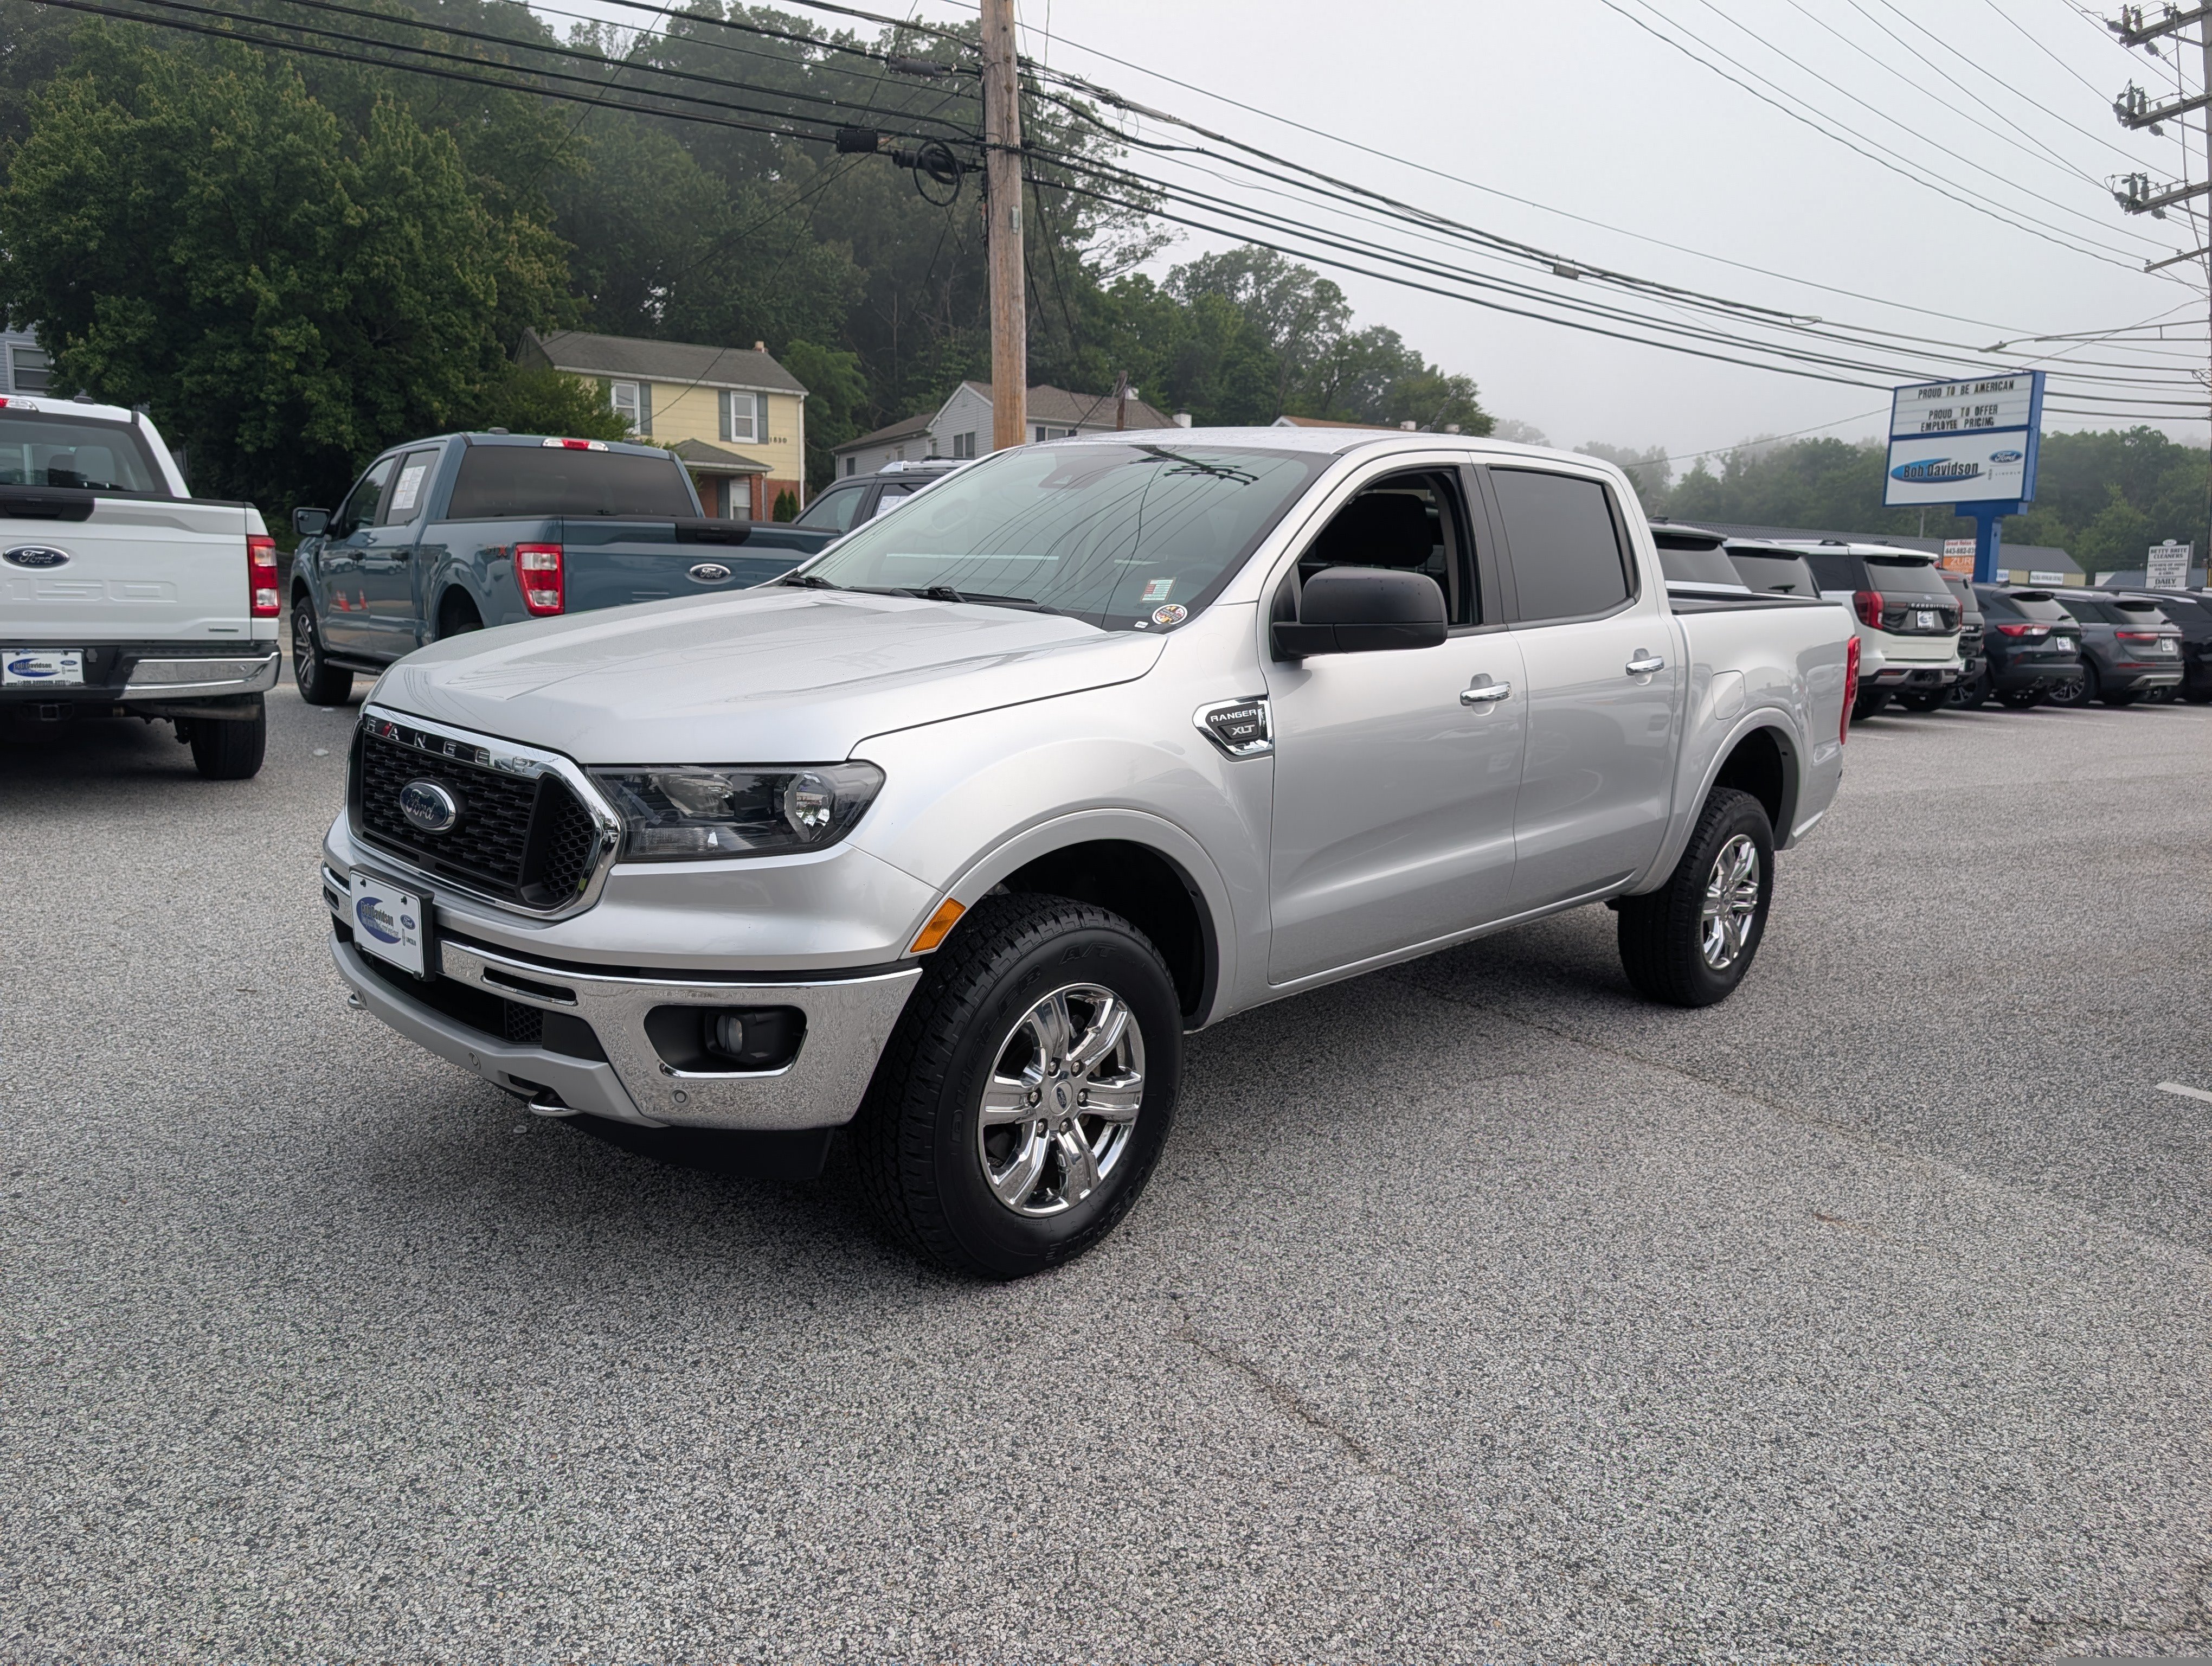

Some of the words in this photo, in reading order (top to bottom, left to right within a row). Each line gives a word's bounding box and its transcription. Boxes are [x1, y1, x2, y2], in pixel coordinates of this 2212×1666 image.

[1918, 388, 1941, 399] PROUD
[1947, 386, 1956, 396] TO
[1960, 384, 1970, 395] BE
[1974, 380, 2014, 394] AMERICAN
[1929, 409, 1952, 420] PROUD
[1961, 407, 1970, 417] TO
[1975, 404, 1998, 416] OFFER
[1920, 419, 1957, 432] EMPLOYEE
[1964, 416, 1994, 428] PRICING
[1995, 452, 2017, 462] Ford
[1904, 465, 1924, 478] Bob
[1927, 462, 1979, 476] Davidson
[19, 549, 55, 563] Ford
[700, 568, 722, 578] Ford
[1211, 709, 1256, 722] RANGER
[1232, 724, 1255, 735] XLT
[366, 717, 532, 775] RANGER
[406, 789, 436, 821] Ford
[361, 902, 371, 917] Bob
[372, 906, 394, 926] Davidson
[403, 915, 414, 927] Ford
[1058, 1090, 1066, 1105] Ford
